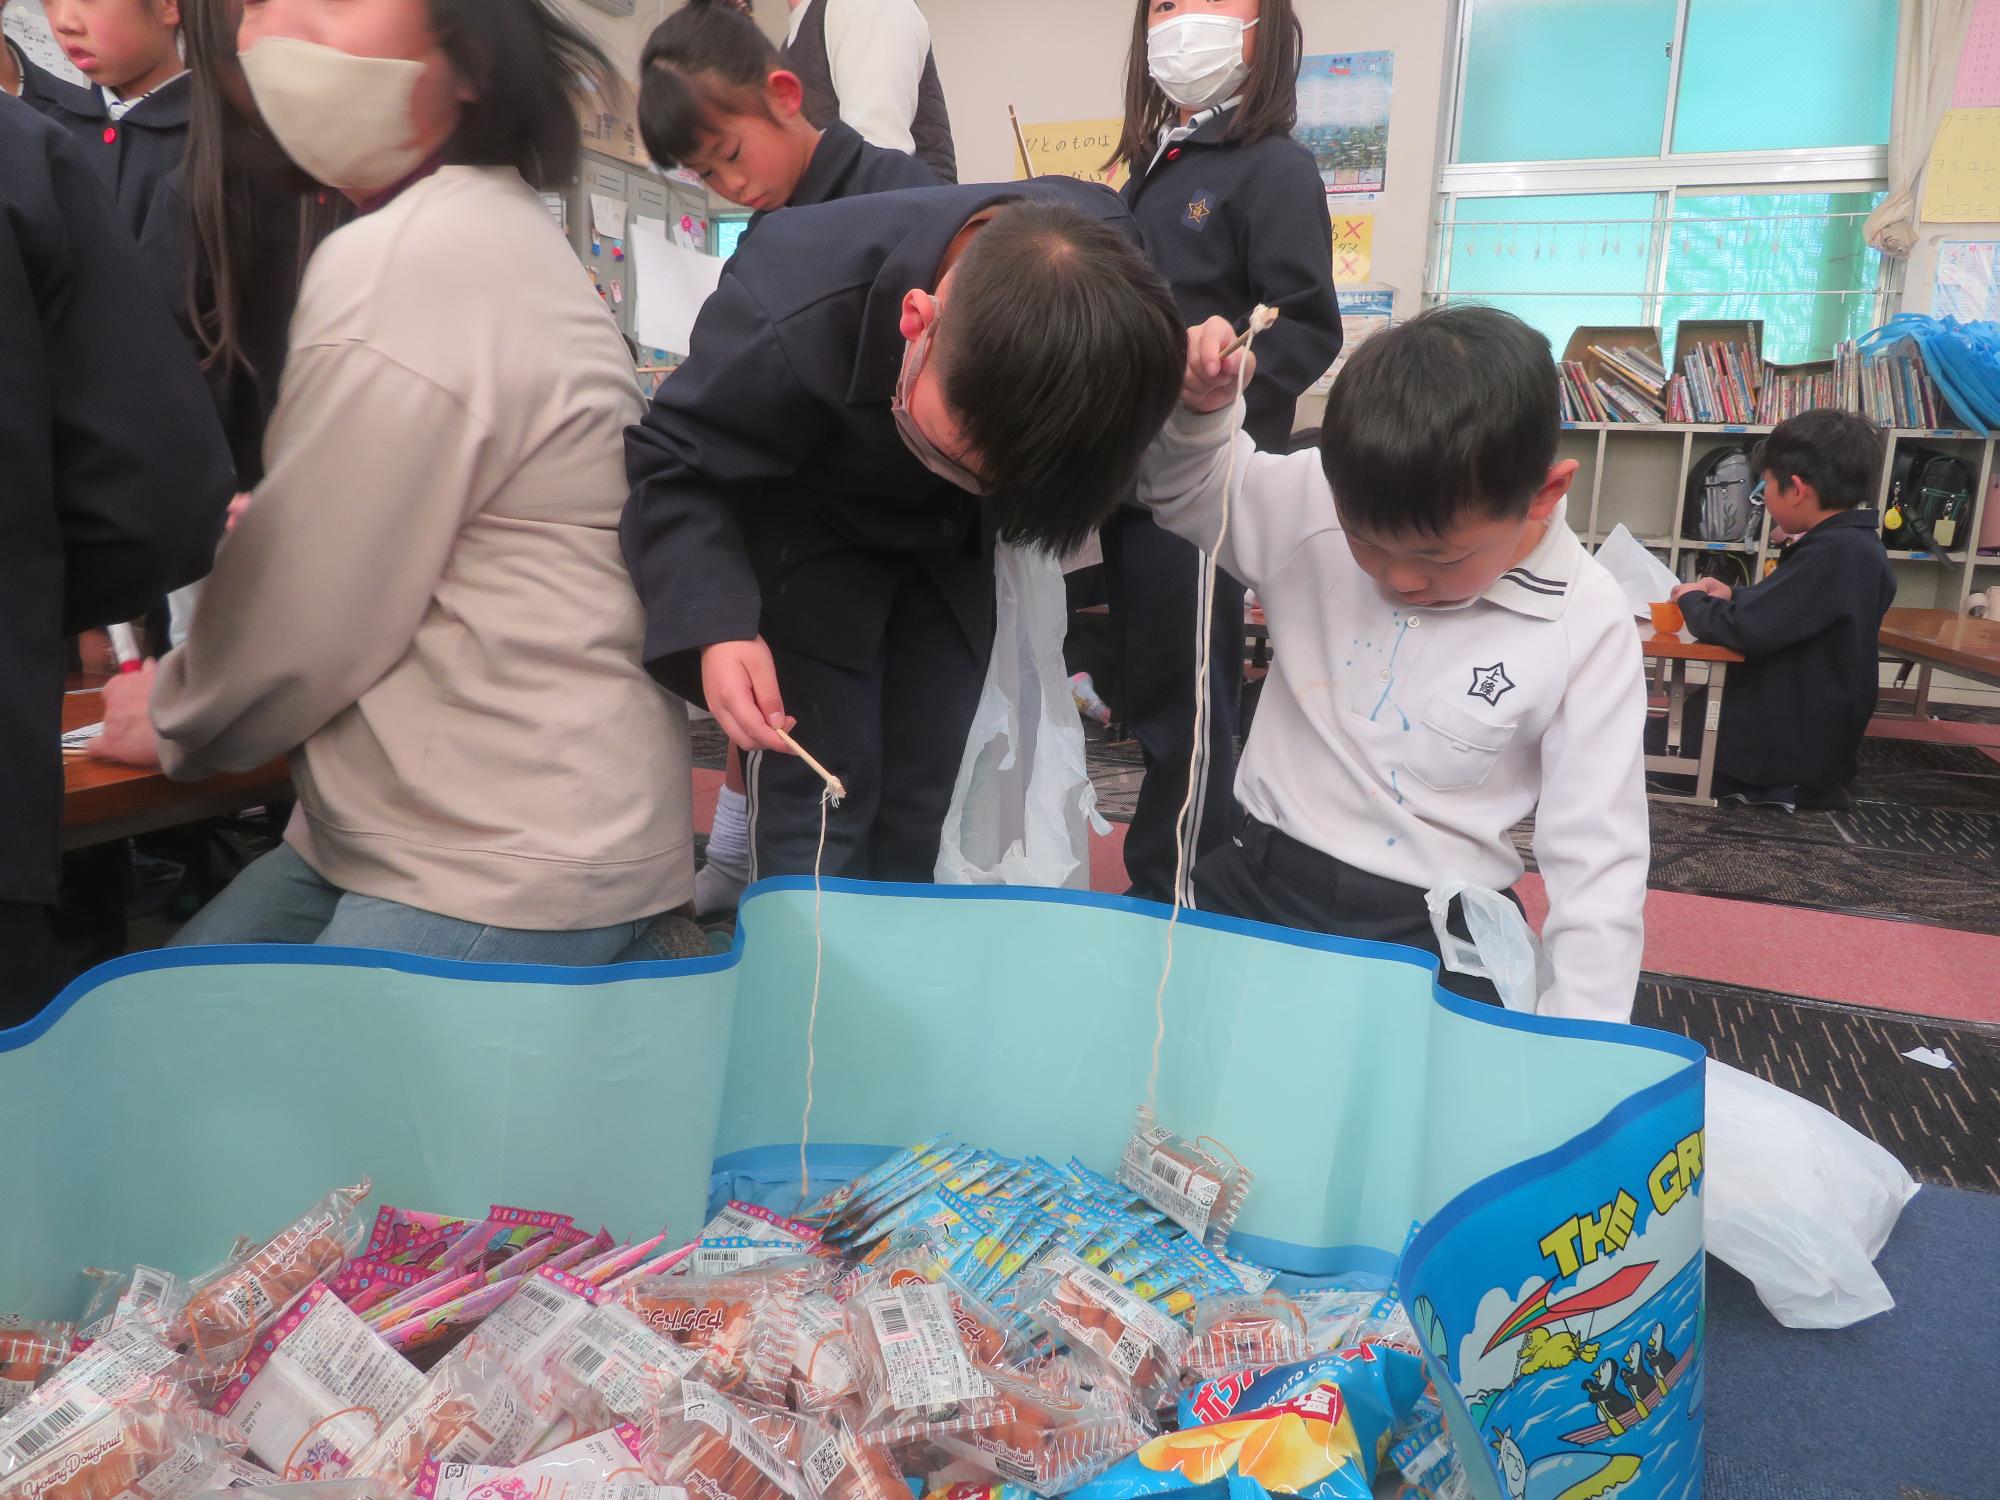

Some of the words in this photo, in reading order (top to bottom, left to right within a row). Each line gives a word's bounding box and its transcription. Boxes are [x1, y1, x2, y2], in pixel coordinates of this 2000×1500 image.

[1538, 1186, 1640, 1280] THE
[1646, 1127, 1705, 1217] GR
[25, 1467, 68, 1497] Young
[65, 1432, 122, 1472] Doughnut
